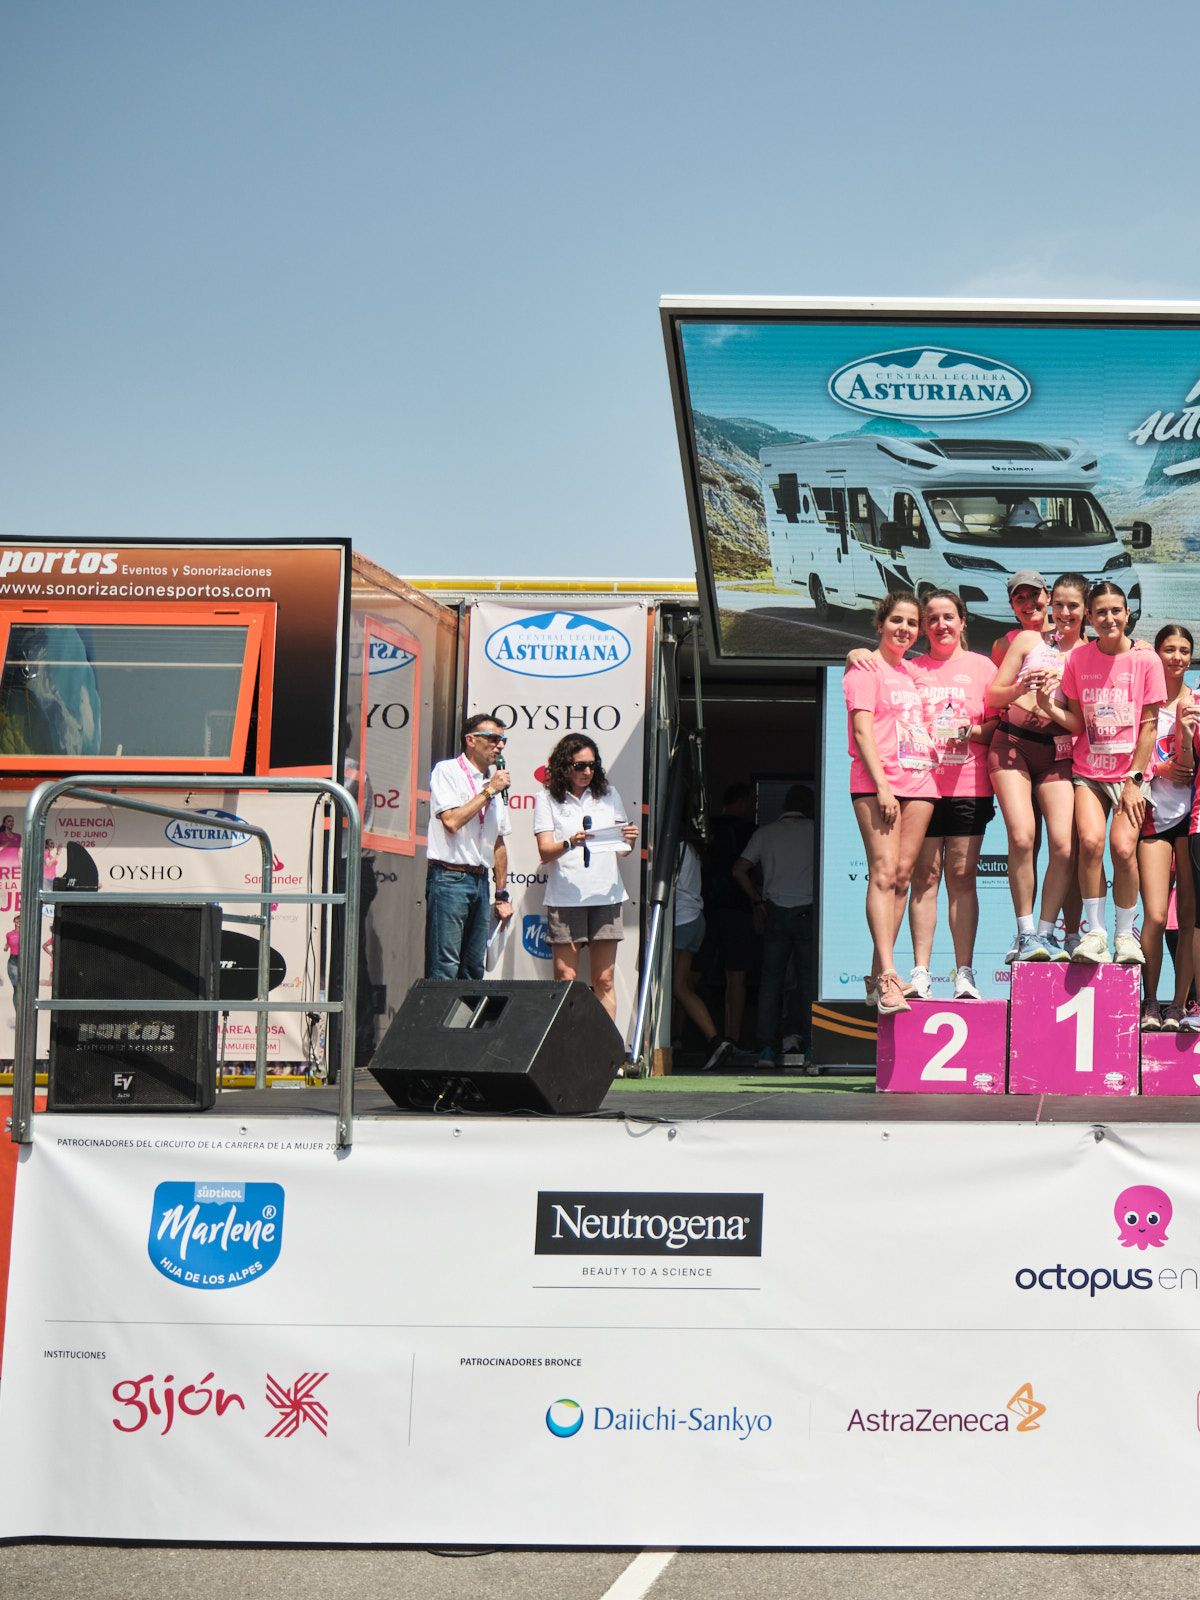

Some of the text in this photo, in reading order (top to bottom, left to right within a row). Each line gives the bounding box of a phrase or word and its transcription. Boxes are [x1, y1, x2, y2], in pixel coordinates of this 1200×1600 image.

[849, 373, 1014, 401] ASTURIANA
[122, 564, 168, 577] Eventos
[172, 568, 178, 578] y
[183, 565, 272, 578] Sonorizaciones
[0, 581, 271, 600] www.sonorizacionesportos.com
[495, 635, 620, 661] ASTURIANA
[491, 704, 621, 732] OYSHO
[1097, 726, 1117, 736] 016
[59, 818, 114, 828] VALENCIA
[64, 831, 69, 839] 7
[83, 831, 108, 839] JUNIO
[109, 864, 183, 881] OYSHO
[1056, 987, 1095, 1072] 1
[920, 1012, 969, 1082] 2
[114, 1074, 133, 1090] EV
[57, 1138, 134, 1148] PATROCINADORES
[136, 1139, 152, 1148] DEL
[154, 1140, 196, 1149] CIRCUITO
[198, 1140, 209, 1149] DE
[211, 1141, 222, 1149] LA
[224, 1141, 265, 1150] CARRERA
[267, 1141, 278, 1150] DE
[281, 1142, 292, 1150] LA
[294, 1142, 324, 1150] MUJER
[157, 1204, 276, 1260] Marlene
[551, 1204, 747, 1249] Neutrogena
[160, 1256, 263, 1285] HIJA DE LOS ALPES
[582, 1267, 712, 1277] BEAUTY TO A SCIENCE
[1015, 1264, 1154, 1297] octopus
[44, 1350, 106, 1360] INSTITUCIONES
[460, 1357, 582, 1367] PATROCINADORES BRONCE
[112, 1371, 245, 1436] gijón
[593, 1406, 772, 1440] Daiichi-Sankyo
[847, 1408, 1009, 1432] AstraZeneca
